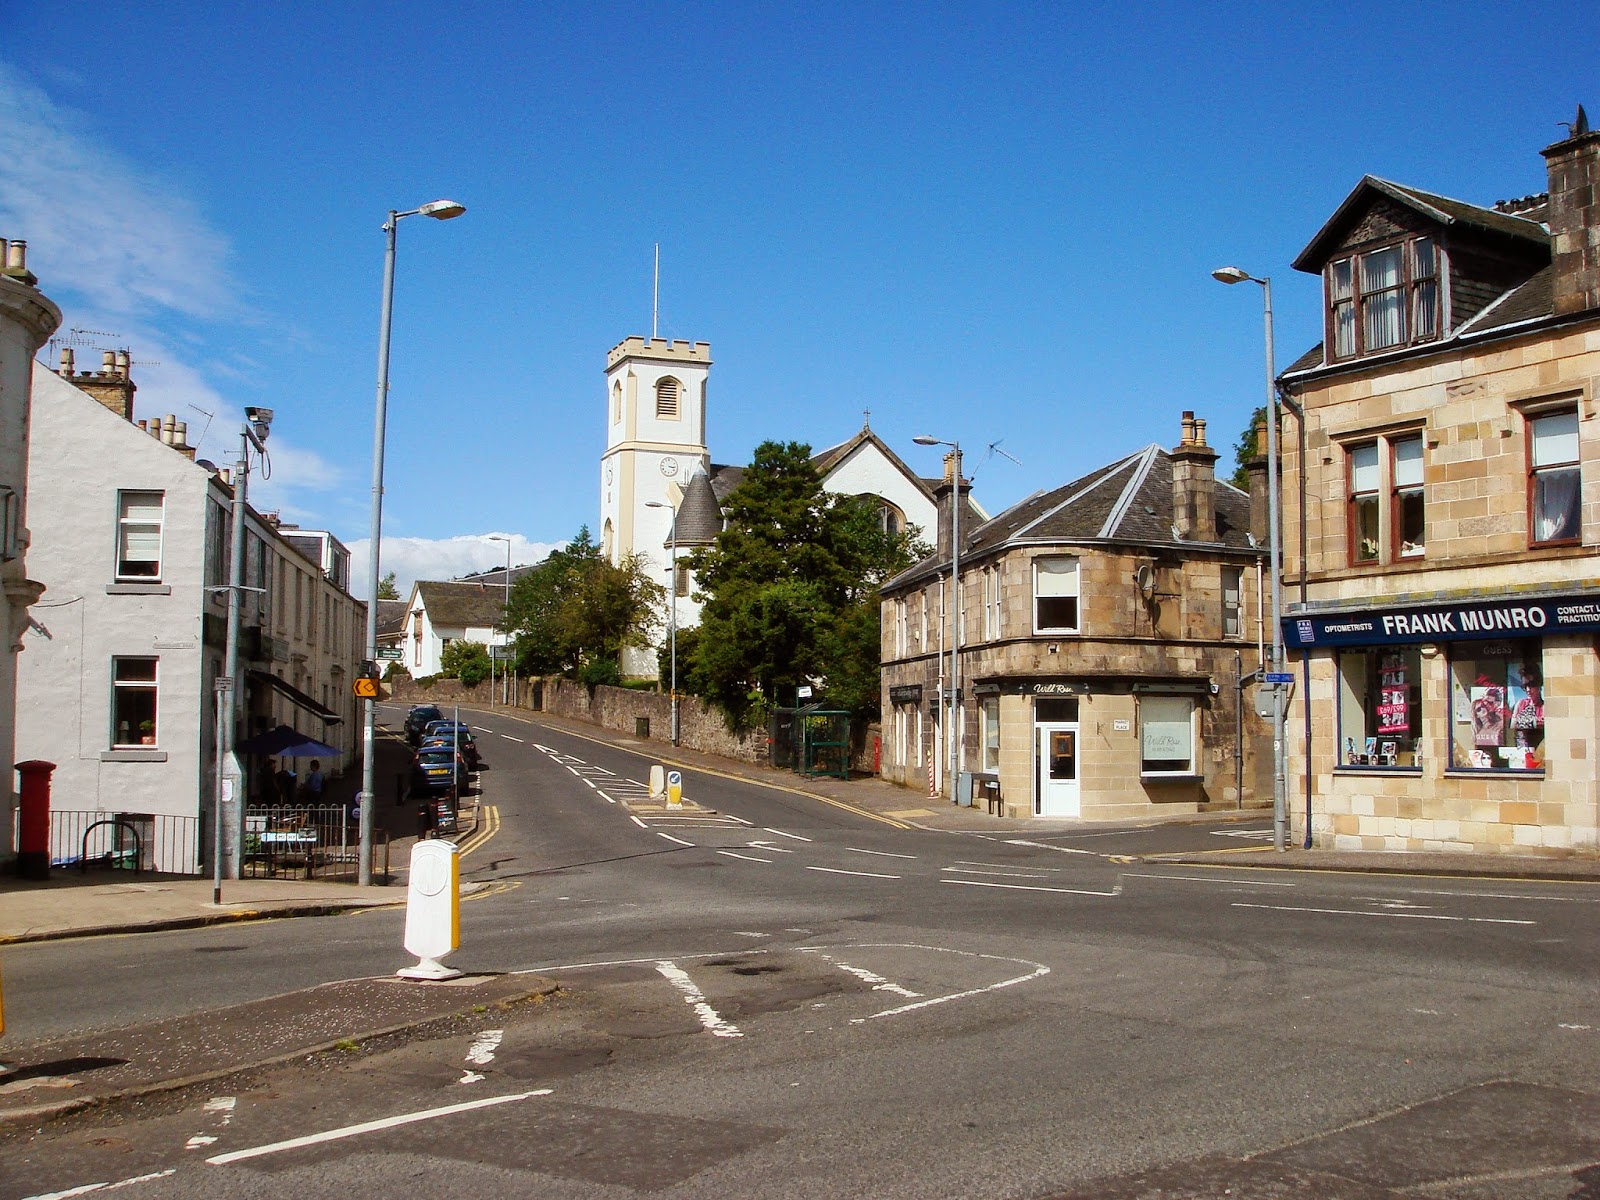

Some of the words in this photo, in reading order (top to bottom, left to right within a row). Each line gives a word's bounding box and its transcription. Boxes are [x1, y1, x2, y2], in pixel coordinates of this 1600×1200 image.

[1557, 604, 1594, 615] CONTACT
[1382, 612, 1457, 635] FRANK
[1459, 606, 1547, 632] MUNRO
[1557, 613, 1600, 624] PRACTITIO
[1324, 623, 1373, 633] OPTOMETRISTS
[1483, 646, 1512, 655] GUESS
[1033, 683, 1056, 693] Wild
